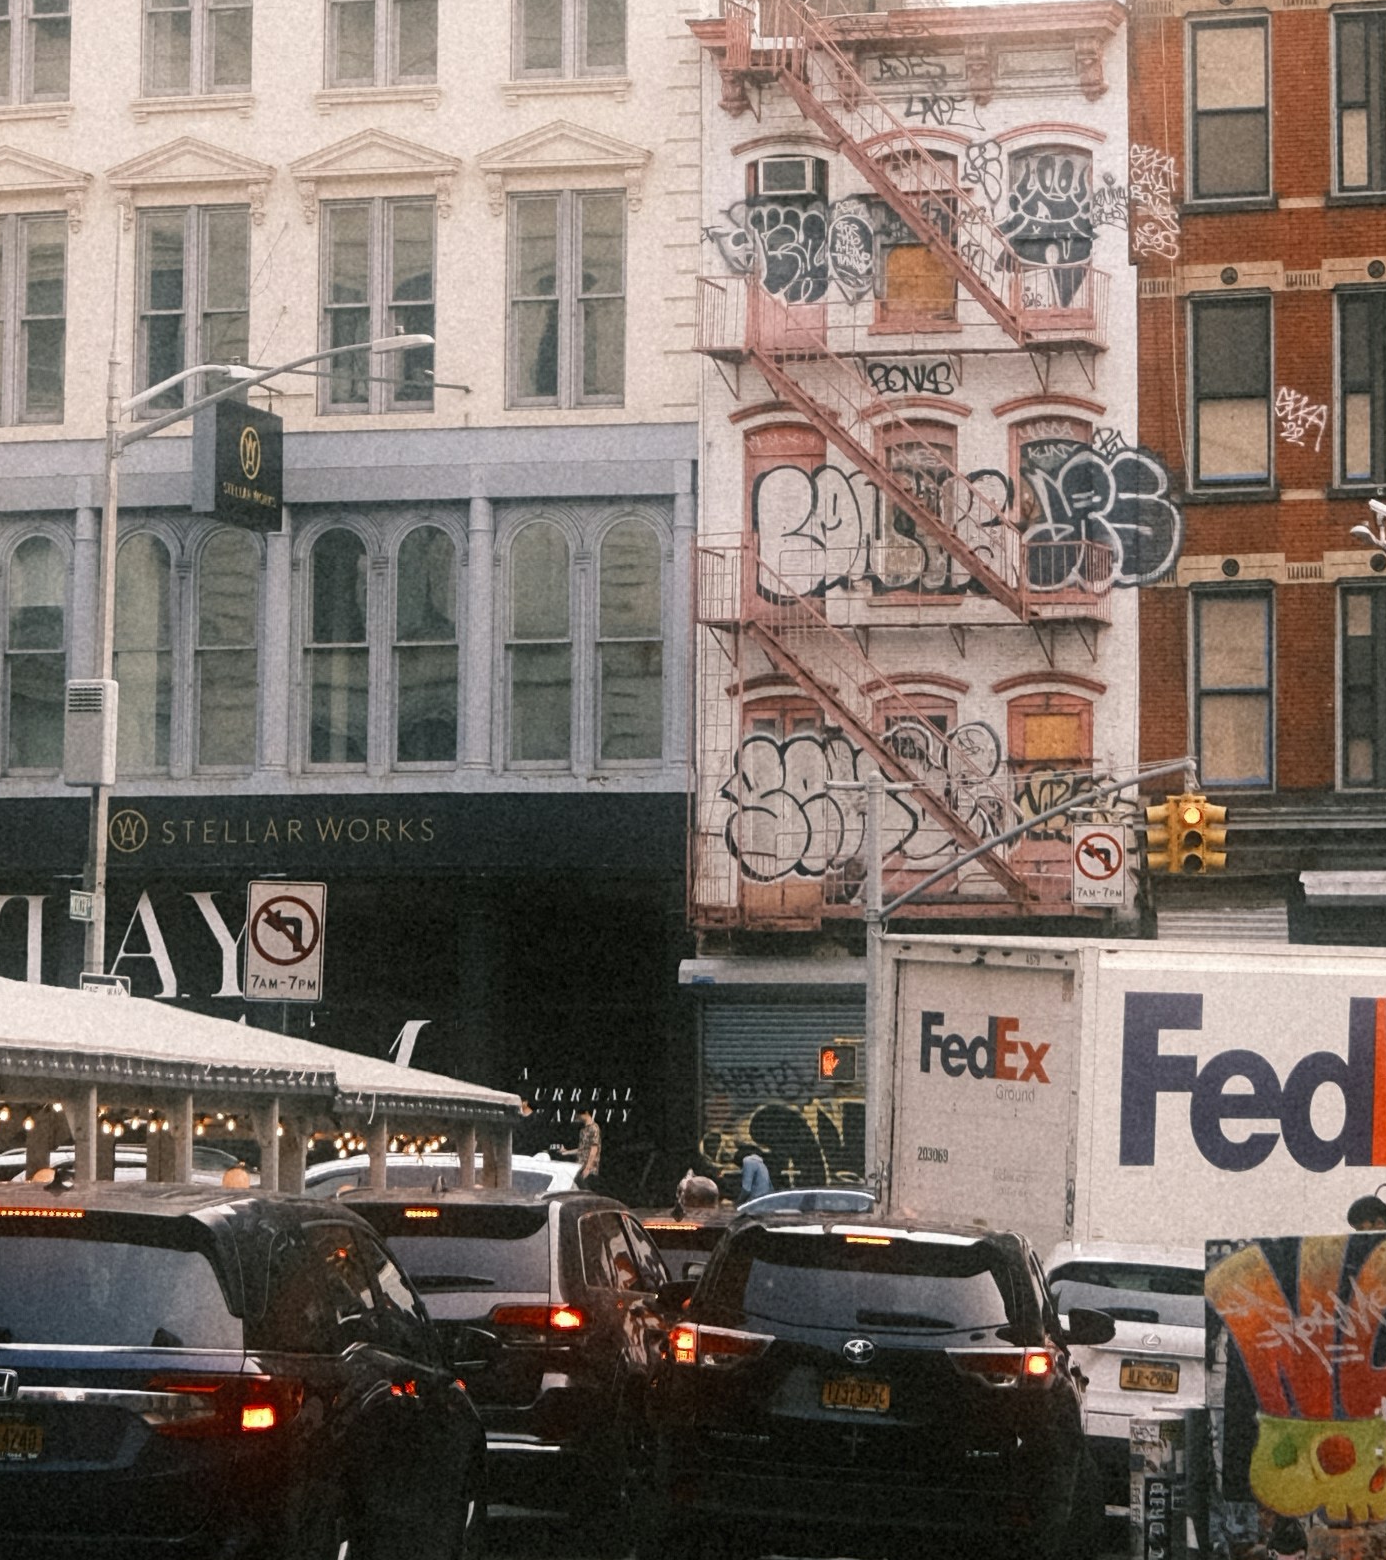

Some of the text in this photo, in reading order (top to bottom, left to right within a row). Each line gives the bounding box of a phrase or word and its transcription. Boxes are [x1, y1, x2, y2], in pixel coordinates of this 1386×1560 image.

[162, 816, 435, 844] STELLAR WORKS
[1075, 886, 1123, 900] 7AM-7PM
[250, 973, 317, 991] 7AM-7PM
[919, 1010, 1052, 1085] FedEx
[995, 1083, 1036, 1103] Ground
[917, 1145, 949, 1163] 203069
